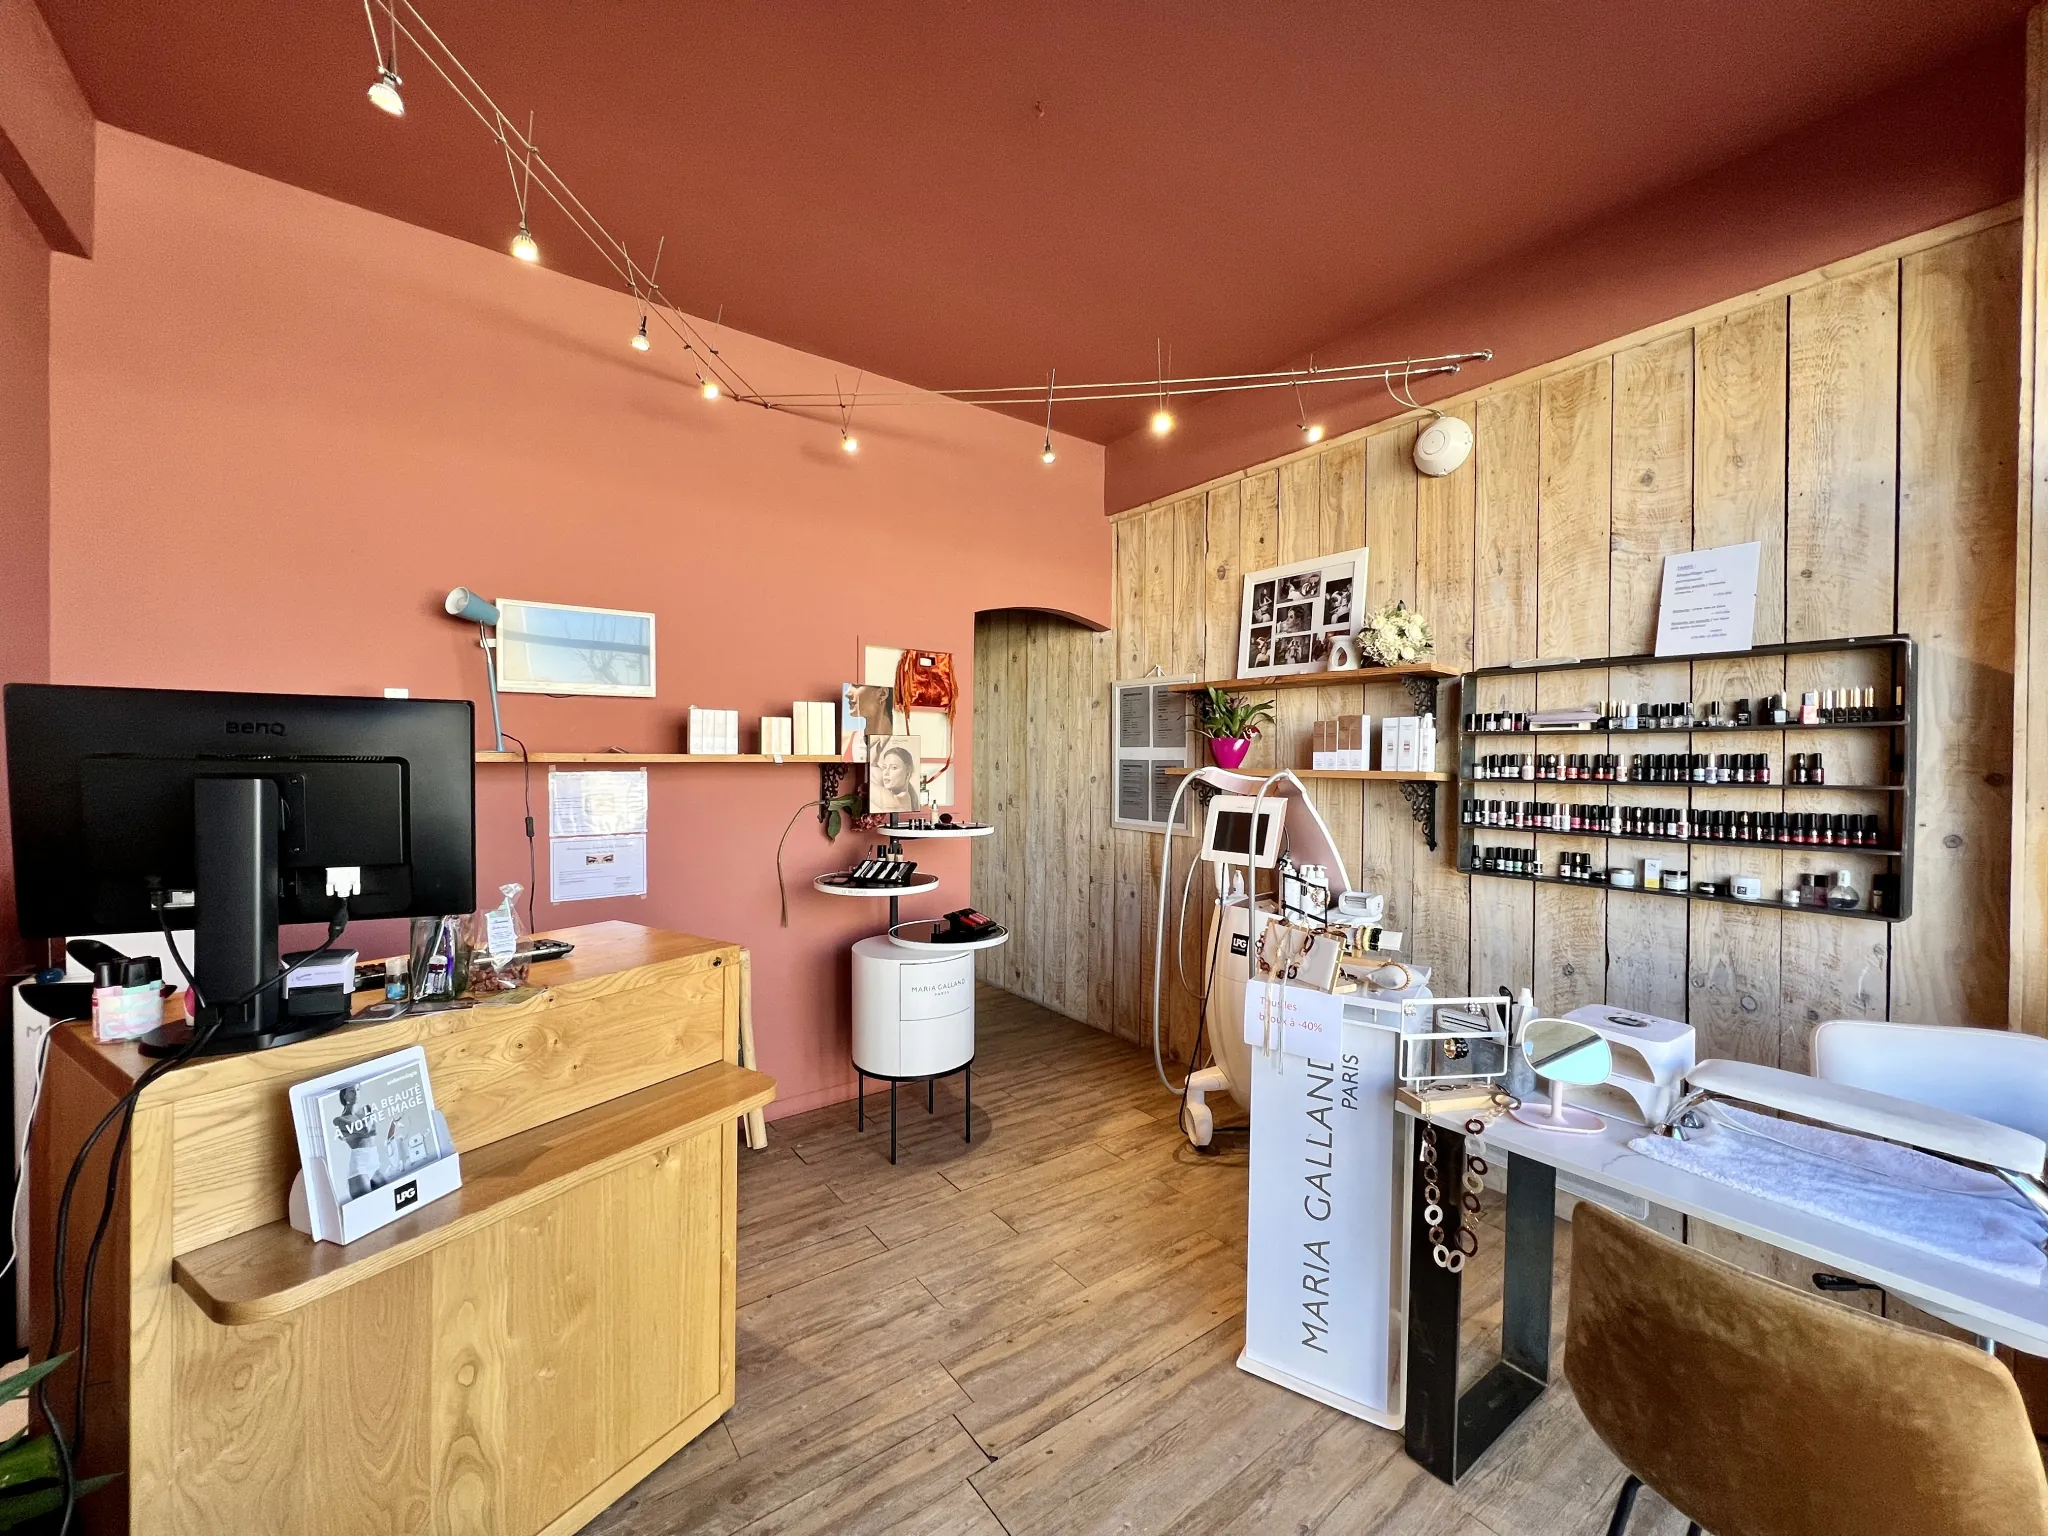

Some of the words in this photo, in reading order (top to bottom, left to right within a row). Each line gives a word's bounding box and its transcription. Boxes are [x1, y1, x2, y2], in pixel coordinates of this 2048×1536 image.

[224, 721, 287, 736] BenQ
[1233, 938, 1247, 949] LPG
[911, 983, 936, 993] MARIA
[937, 978, 966, 991] GALLAND
[1260, 996, 1282, 1009] Tus
[1284, 1001, 1298, 1012] les
[1289, 1018, 1295, 1027] à
[1298, 1021, 1323, 1033] -40%
[1341, 1053, 1359, 1111] PARIS
[364, 1102, 379, 1117] LA
[380, 1082, 422, 1109] BEAUTÉ
[334, 1125, 343, 1141] À
[345, 1111, 385, 1135] VOTRE
[387, 1094, 424, 1119] IMAGE
[396, 1187, 416, 1204] LPG
[1301, 1240, 1331, 1354] MARIA
